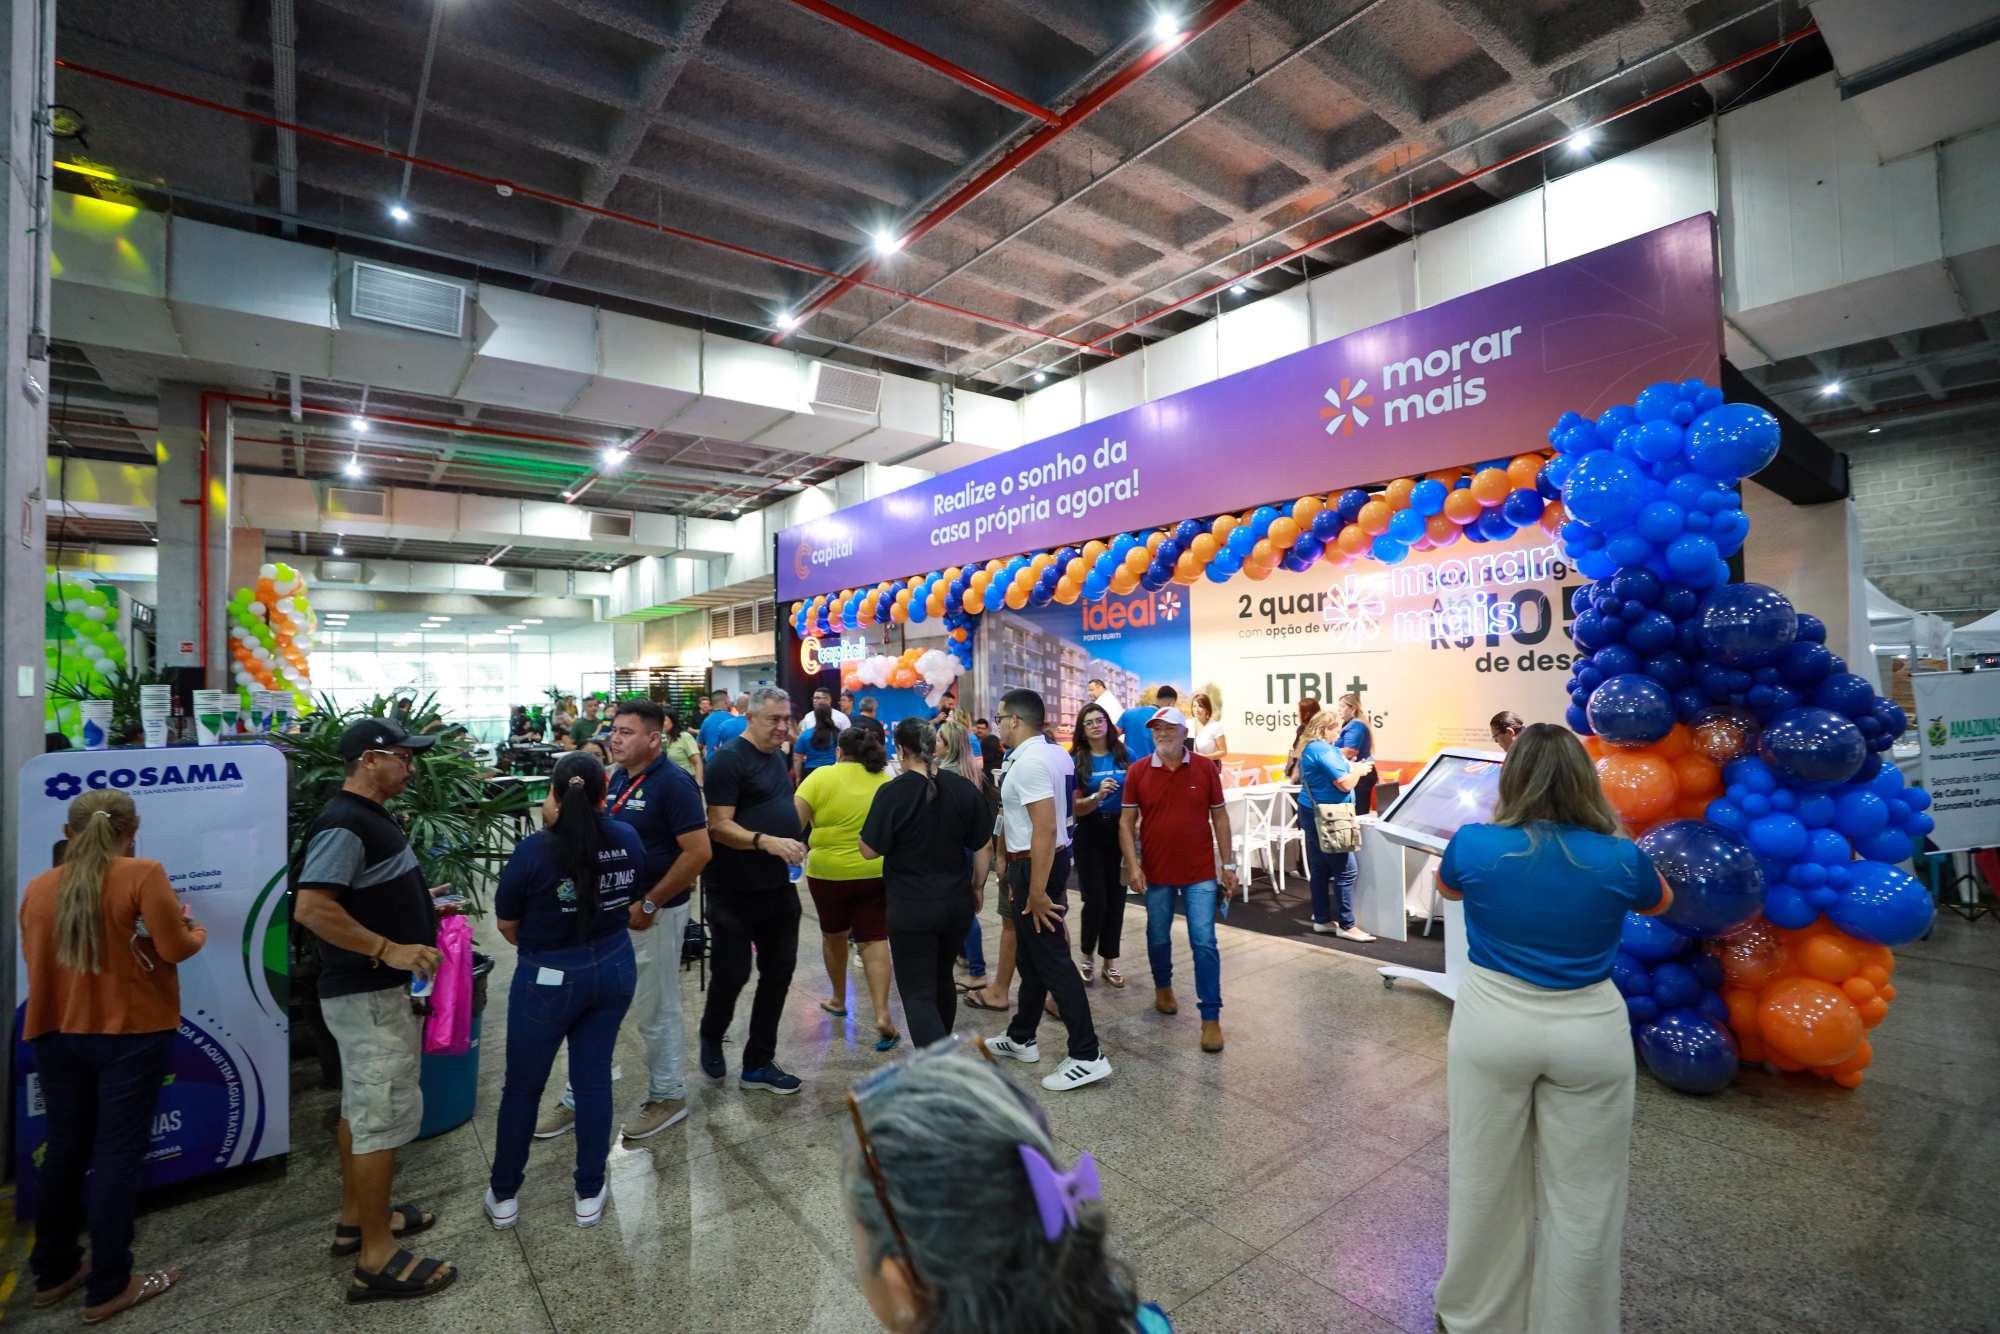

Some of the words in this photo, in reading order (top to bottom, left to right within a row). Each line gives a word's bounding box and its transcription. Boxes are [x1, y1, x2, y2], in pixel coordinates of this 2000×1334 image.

[1383, 325, 1522, 390] morar
[1384, 374, 1487, 426] mais
[934, 480, 997, 516] Realize
[1001, 476, 1014, 496] o
[1018, 453, 1087, 491] sonho
[1093, 438, 1127, 469] da
[930, 520, 970, 546] casa
[975, 495, 1050, 542] própria
[1056, 469, 1140, 518] agora!
[811, 537, 853, 567] capital
[1392, 541, 1560, 597] morar
[1082, 592, 1156, 631] ideal
[1238, 594, 1253, 619] 2
[1259, 592, 1328, 624] quar
[1393, 590, 1519, 642] mais
[1266, 624, 1302, 639] opção
[1305, 622, 1320, 634] de
[1475, 652, 1510, 673] de
[1267, 672, 1333, 704] ITBI
[1244, 709, 1299, 732] Regist
[86, 762, 243, 789] COSAMA
[188, 869, 222, 879] Gelada
[188, 881, 223, 892] Natural
